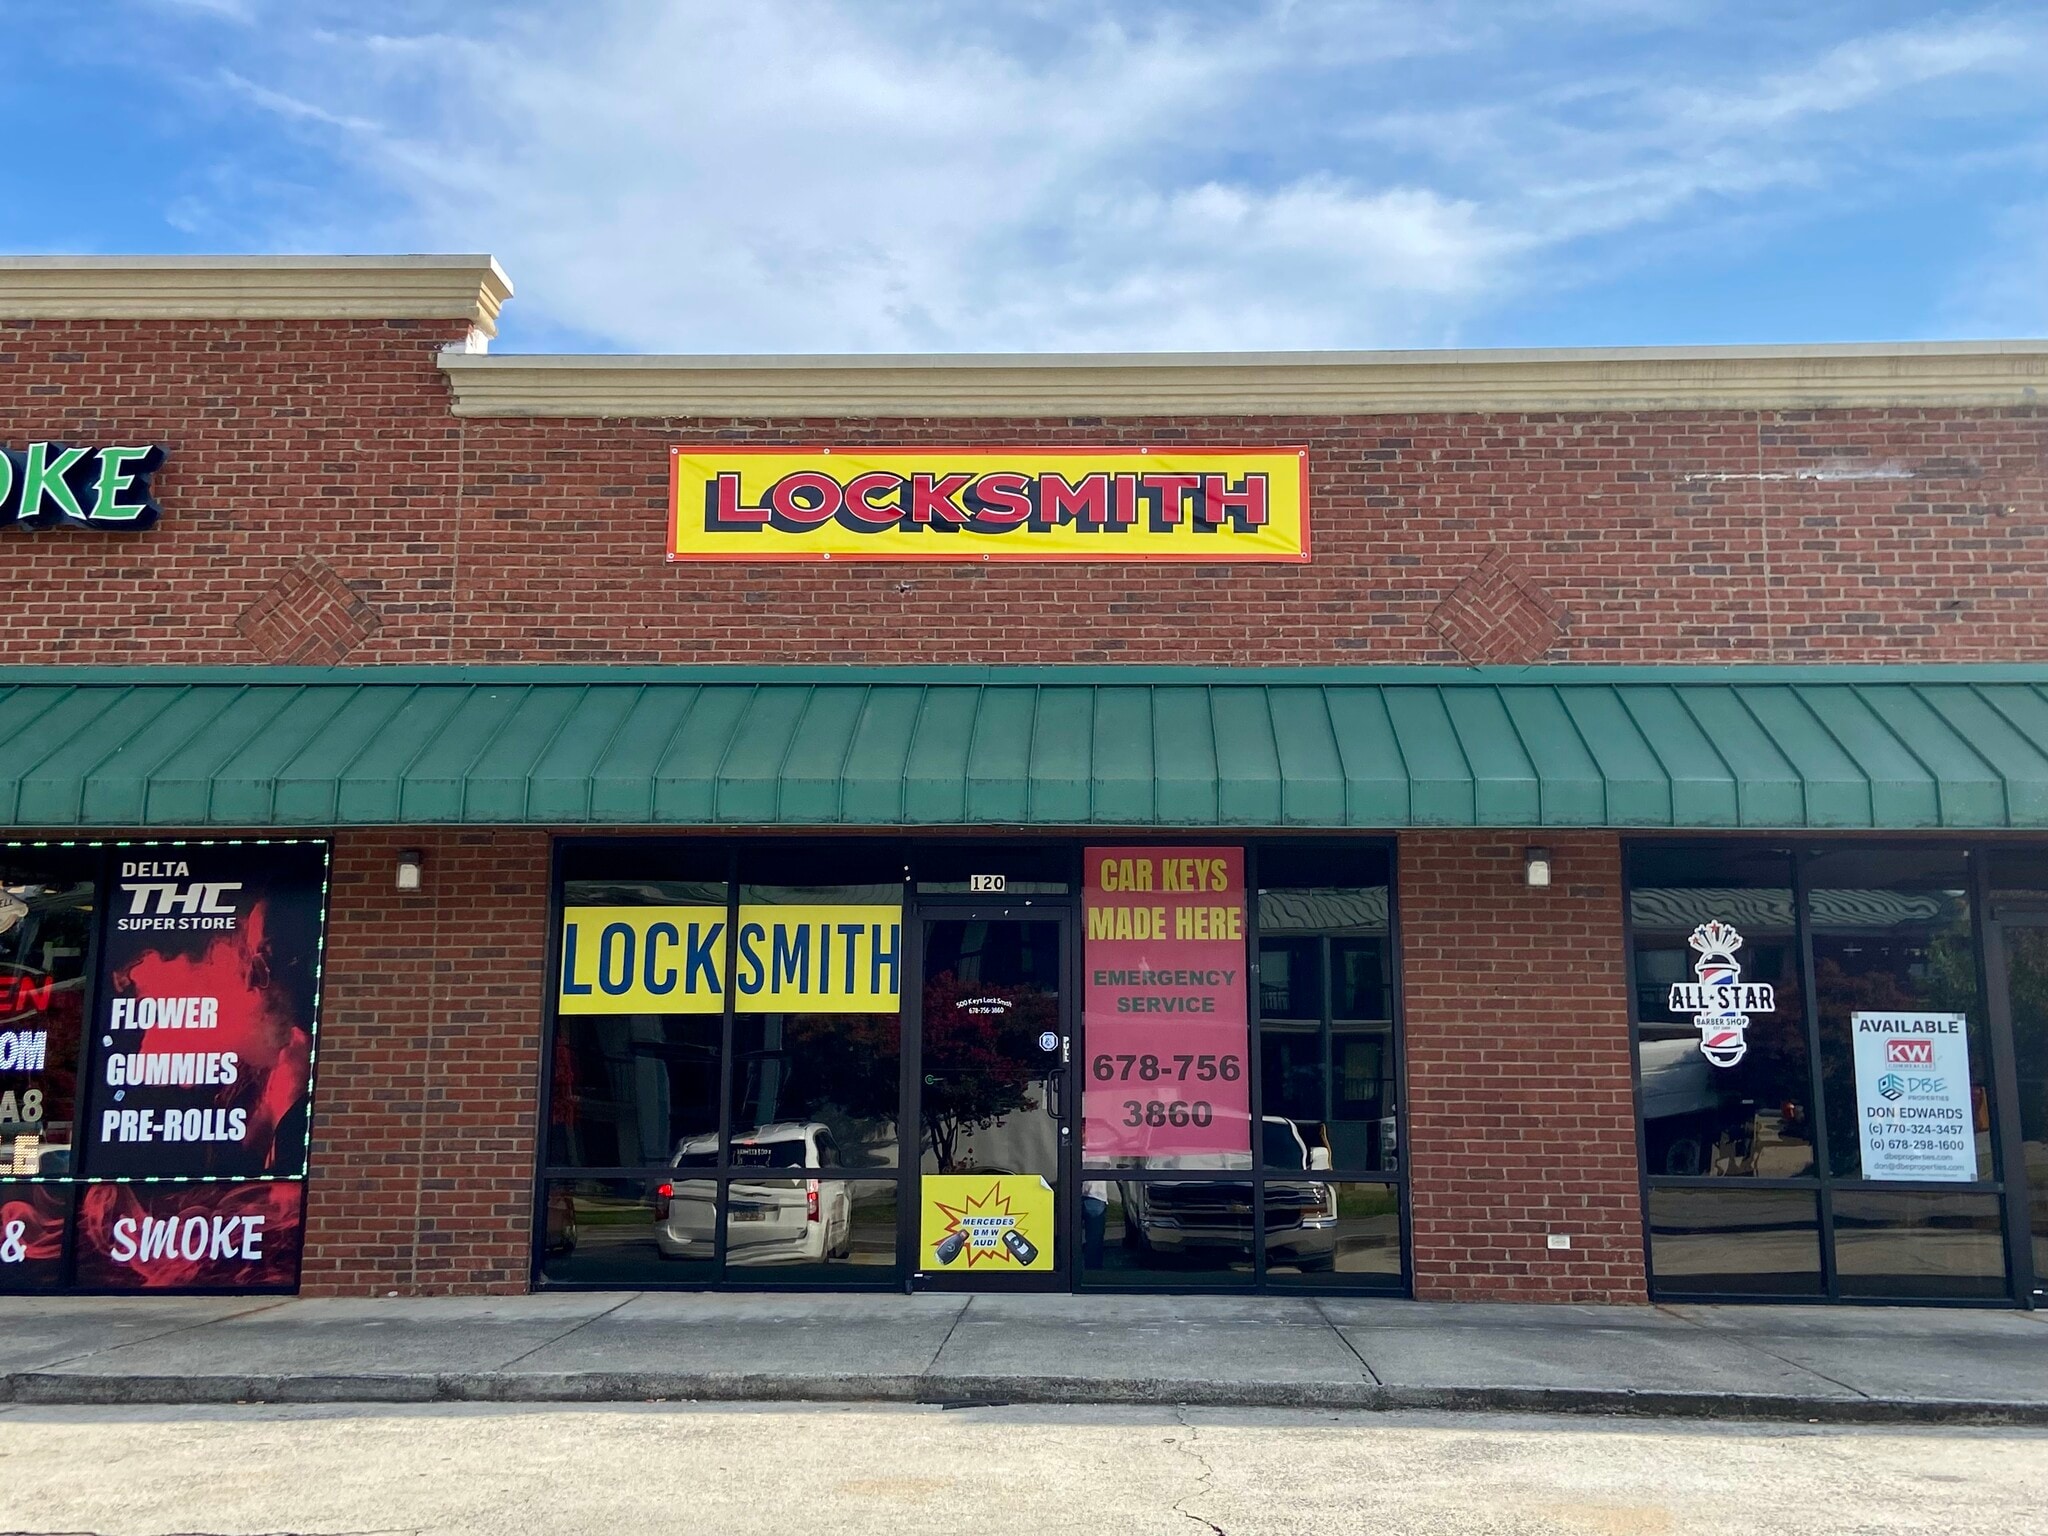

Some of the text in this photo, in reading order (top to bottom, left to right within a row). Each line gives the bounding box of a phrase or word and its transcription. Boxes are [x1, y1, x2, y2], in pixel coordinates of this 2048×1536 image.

[0, 442, 153, 520] KE
[704, 471, 1269, 533] LOCKSMITH
[121, 861, 189, 877] DELTA
[1101, 858, 1228, 892] CAR KEYS
[973, 876, 1004, 890] 120
[120, 882, 243, 914] THC
[118, 917, 236, 930] SUPER STORE
[1088, 907, 1242, 940] MADE HERE
[1093, 970, 1236, 986] EMERGENCY
[1117, 997, 1215, 1013] SERVICE
[1672, 986, 1773, 1009] ALL STAR
[110, 998, 218, 1030] FLOWER
[1696, 1018, 1747, 1026] BARBER SHOP
[1859, 1020, 1959, 1033] AVAILABLE
[1887, 1044, 1930, 1062] KW
[106, 1052, 238, 1086] GUMMIES
[1093, 1055, 1241, 1082] 678-756
[1907, 1078, 1948, 1093] DBE
[1123, 1101, 1213, 1128] 3860
[1867, 1107, 1964, 1120] DON EDWARDS
[101, 1108, 247, 1142] PRE-ROLLS
[1869, 1123, 1963, 1135] (c) 770-324-3457
[1870, 1138, 1965, 1151] (o) 678-298-1600
[1884, 1153, 1953, 1162] dbeproperties.com
[0, 1220, 27, 1262] &
[110, 1215, 265, 1262] SMOKE
